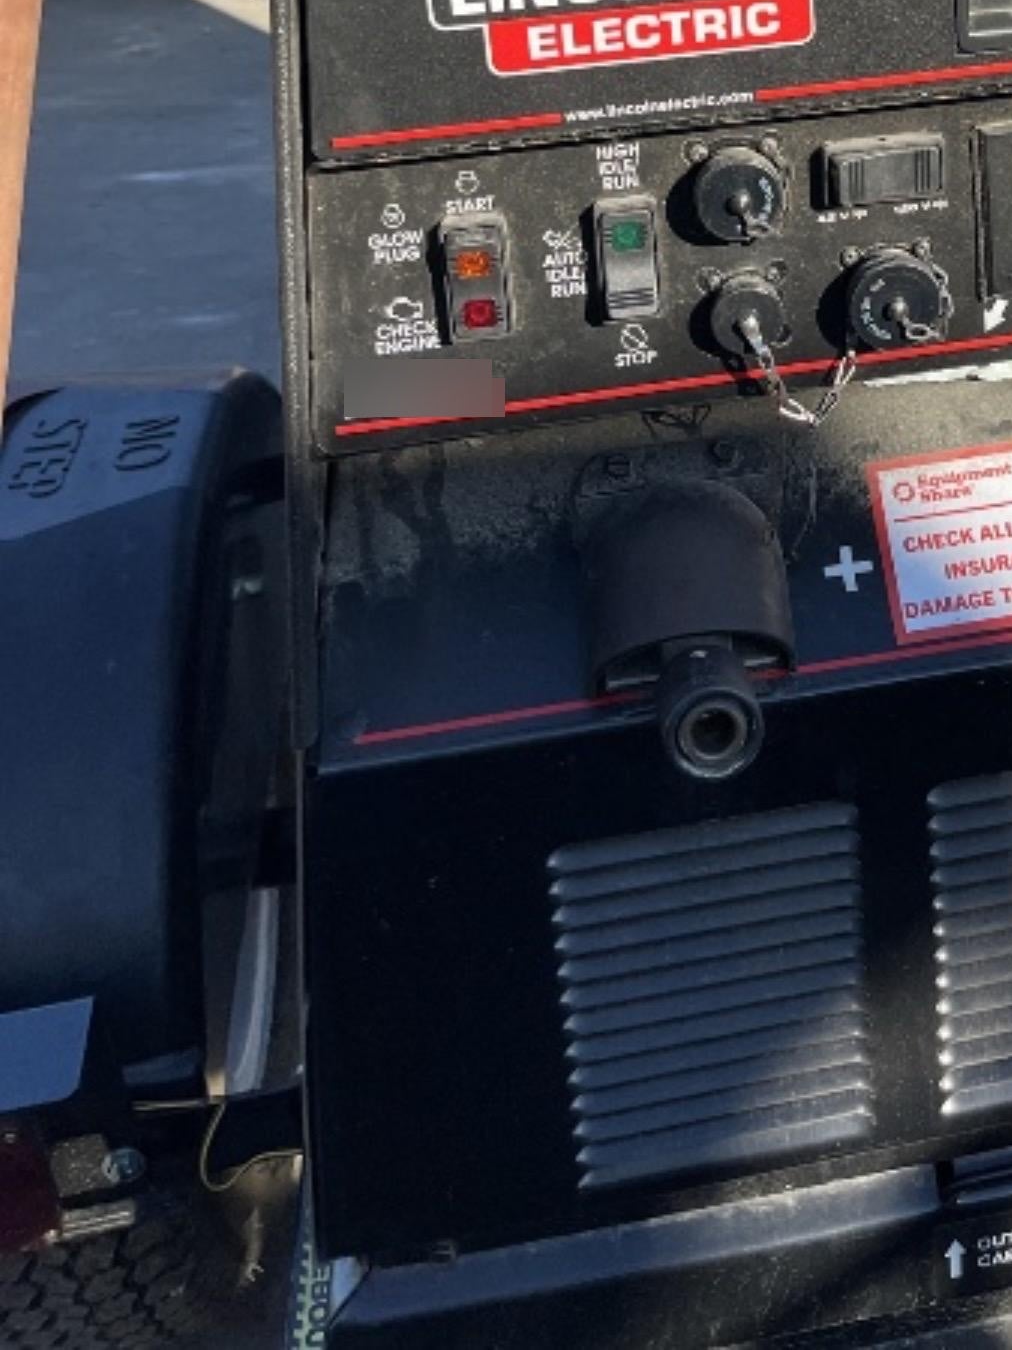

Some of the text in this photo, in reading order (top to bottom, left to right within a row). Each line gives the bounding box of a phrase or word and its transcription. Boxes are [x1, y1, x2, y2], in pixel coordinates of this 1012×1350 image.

[527, 2, 780, 60] ELECTRIC
[564, 91, 754, 123] www.lincolnelectric.com
[596, 142, 640, 160] HIGH
[600, 158, 637, 176] IDLE
[603, 176, 640, 190] RUN
[446, 195, 495, 214] START
[368, 228, 423, 250] GLOW
[373, 247, 420, 265] PLUG
[542, 251, 588, 268] AUTO
[545, 266, 585, 283] IDLE
[551, 281, 587, 298] RUN
[376, 320, 439, 341] CHECK
[374, 335, 442, 356] ENGINE
[615, 350, 658, 368] STOP
[114, 416, 181, 471] NO
[8, 418, 88, 498] STEP
[903, 527, 975, 553] CHECK
[904, 589, 995, 620] DAMAGE
